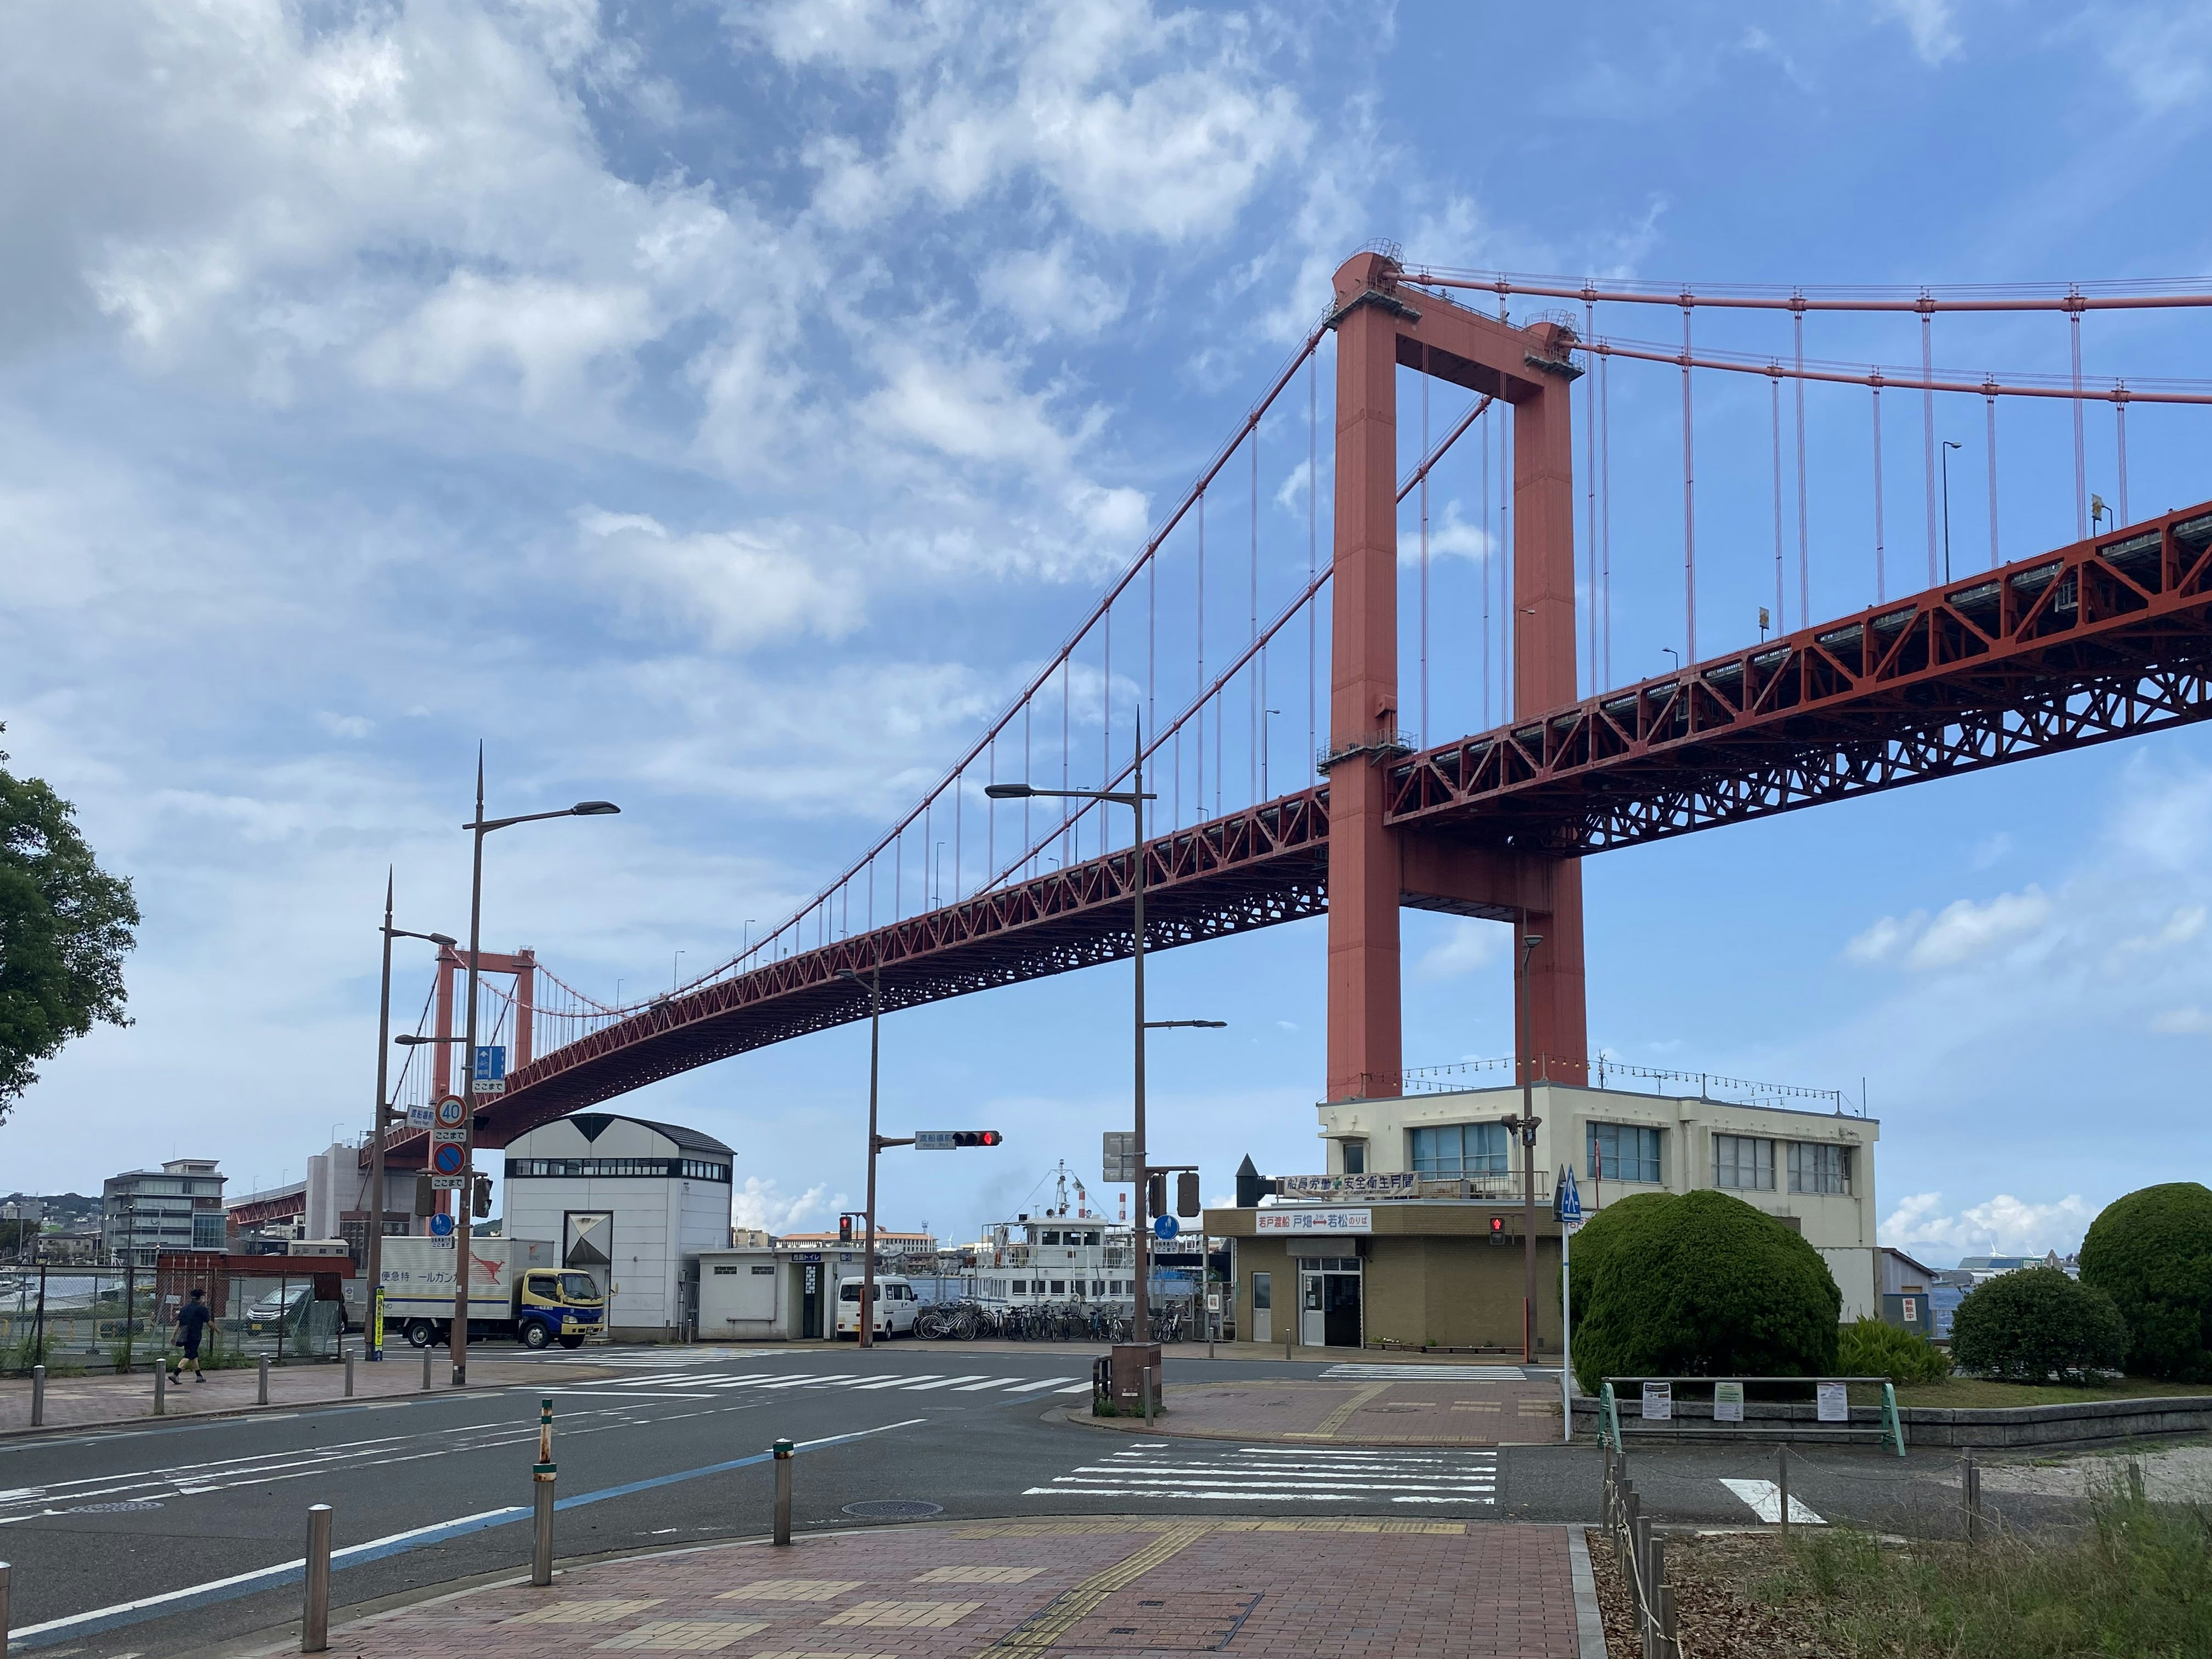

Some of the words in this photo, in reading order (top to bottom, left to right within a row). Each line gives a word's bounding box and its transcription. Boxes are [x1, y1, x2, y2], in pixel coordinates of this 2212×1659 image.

[442, 1104, 459, 1119] 40
[1287, 1177, 1331, 1190] 船員労働
[1344, 1173, 1414, 1189] 安全衛生月間
[1259, 1215, 1290, 1228] 若戸渡船
[1293, 1214, 1312, 1228] 戸畑
[1328, 1214, 1348, 1228] 若松
[1348, 1216, 1367, 1224] のりば
